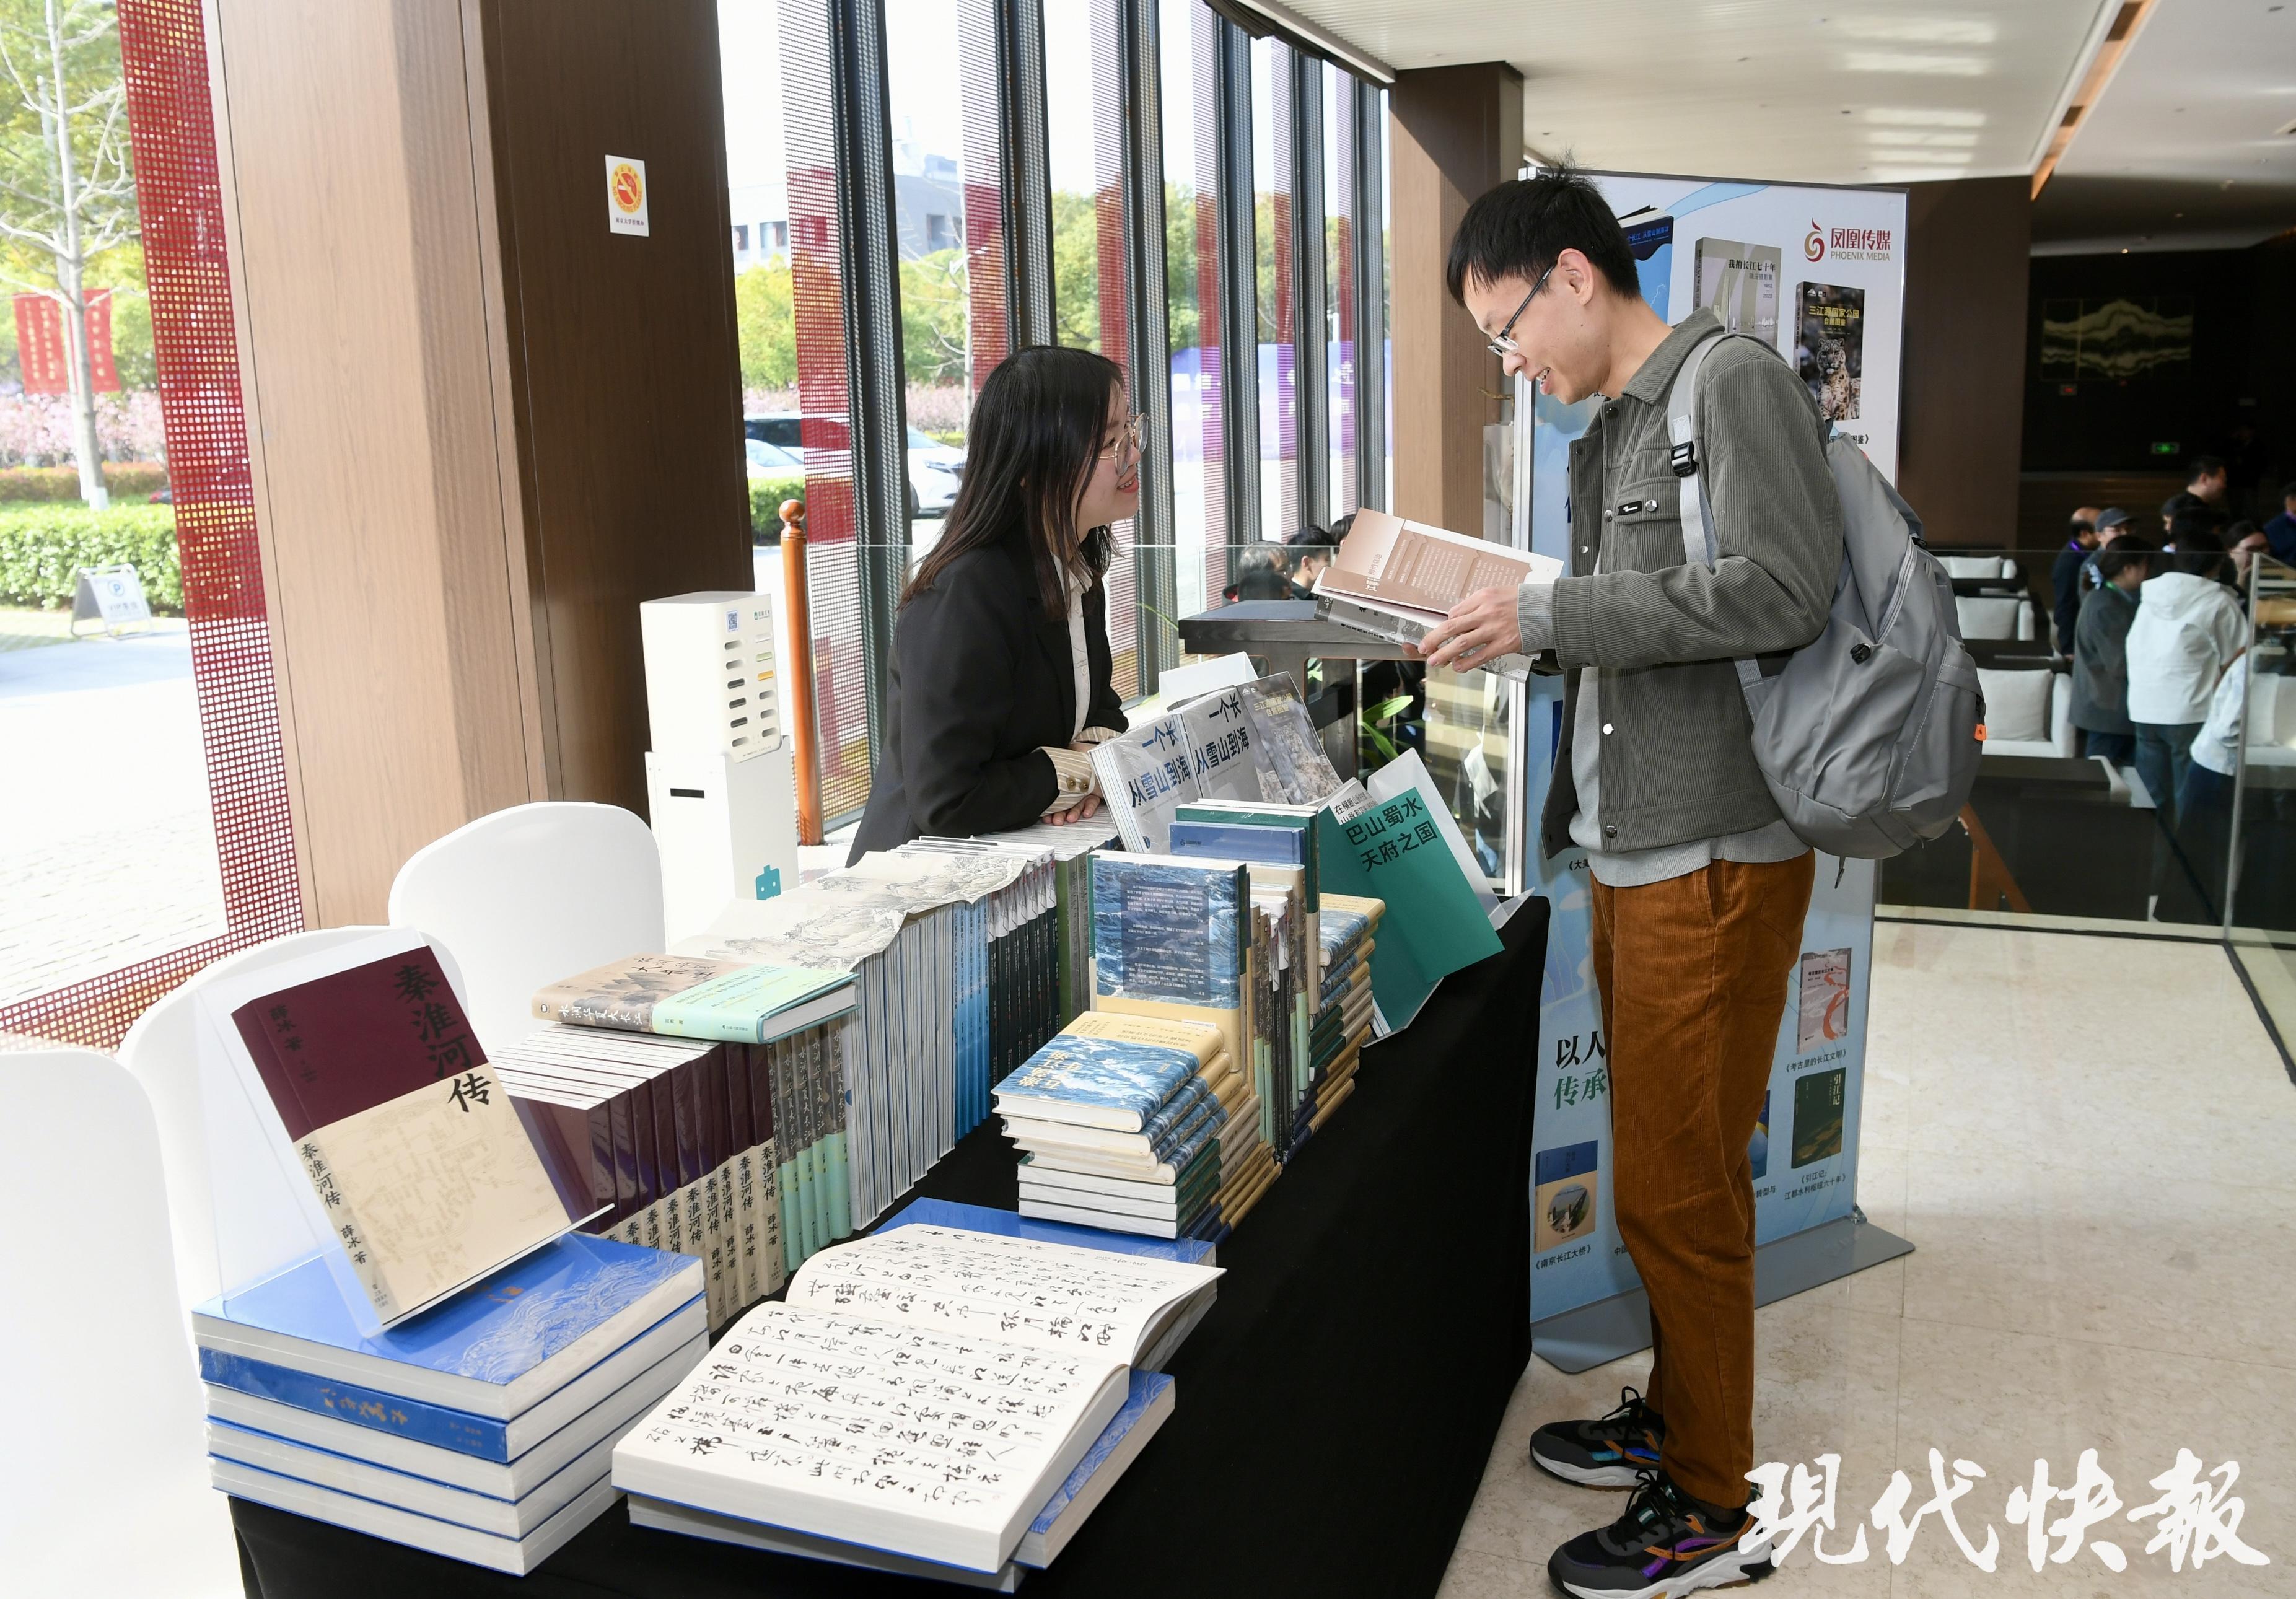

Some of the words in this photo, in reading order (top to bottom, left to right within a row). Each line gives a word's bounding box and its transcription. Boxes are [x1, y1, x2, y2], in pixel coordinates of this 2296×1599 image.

[1830, 227, 1891, 251] 凤凰传媒
[1830, 251, 1864, 260] PHOENIX
[1866, 252, 1890, 261] MEDIA
[1728, 258, 1776, 273] 我拍长江七十年
[1808, 305, 1860, 320] 三江源国家公园
[1142, 719, 1180, 751] 一个长
[1194, 726, 1250, 775] 从雪山到海
[1128, 753, 1191, 808] 从雪山到海
[1346, 797, 1424, 846] 巴山蜀水
[1359, 820, 1438, 873] 天府之国
[269, 1004, 297, 1033] 薛冰
[558, 1004, 644, 1025] 水润华夏大长江
[392, 963, 493, 1113] 秦淮河传
[1555, 1030, 1606, 1070] 以人
[1786, 1049, 1847, 1073] 《考古里的长江文明》
[1553, 1067, 1608, 1110] 传承
[1833, 1073, 1842, 1106] 引江记
[739, 1155, 754, 1211] 秦淮河传
[761, 1146, 776, 1201] 秦淮河传
[1784, 1173, 1846, 1201] 江都水利枢纽六十年》
[301, 1142, 341, 1207] 秦淮河传
[340, 1224, 362, 1249] 薛冰
[354, 1251, 367, 1266] 著
[705, 1177, 720, 1235] 秦淮河传
[721, 1167, 734, 1223] 秦淮河传
[686, 1187, 703, 1245] 秦淮河传
[1535, 1243, 1592, 1271] 《南京长江大桥》
